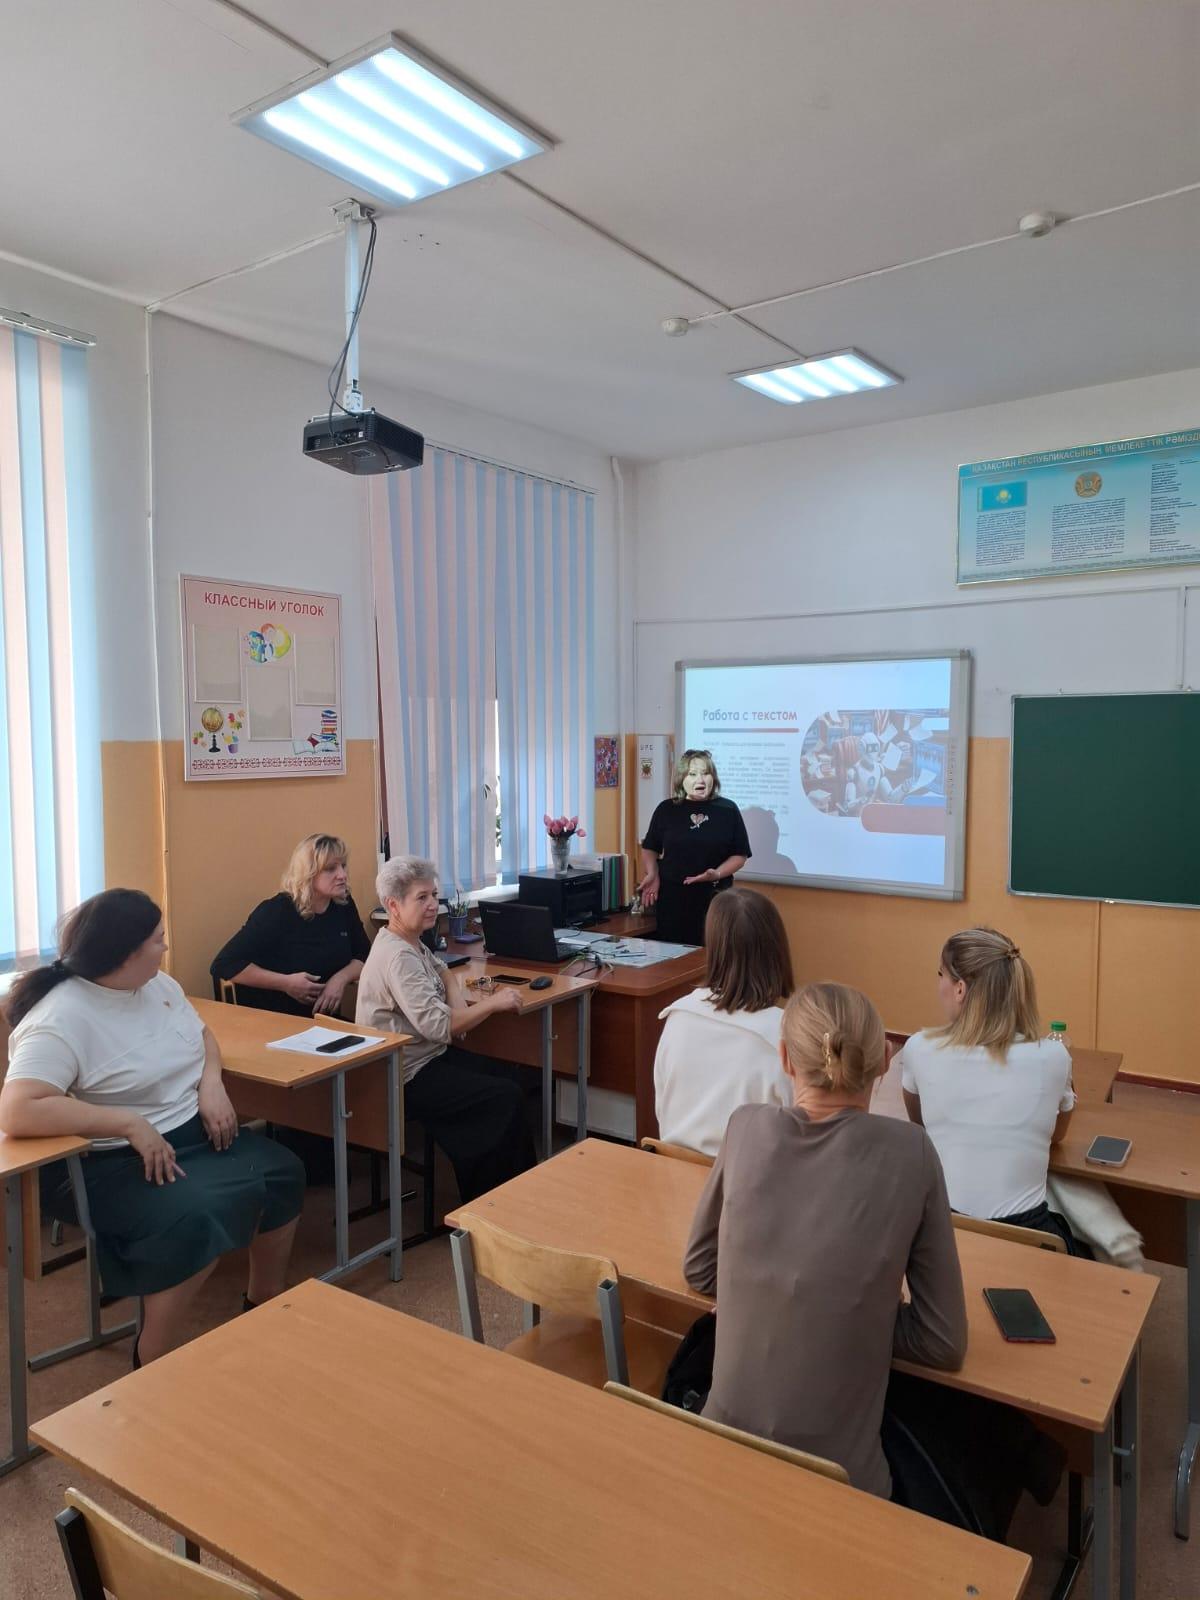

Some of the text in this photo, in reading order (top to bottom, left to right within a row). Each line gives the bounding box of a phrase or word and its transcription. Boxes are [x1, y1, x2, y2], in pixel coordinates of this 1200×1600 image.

[204, 591, 325, 616] КЛАССНЫЙ УГОЛОК
[703, 709, 798, 721] Работа с текстом
